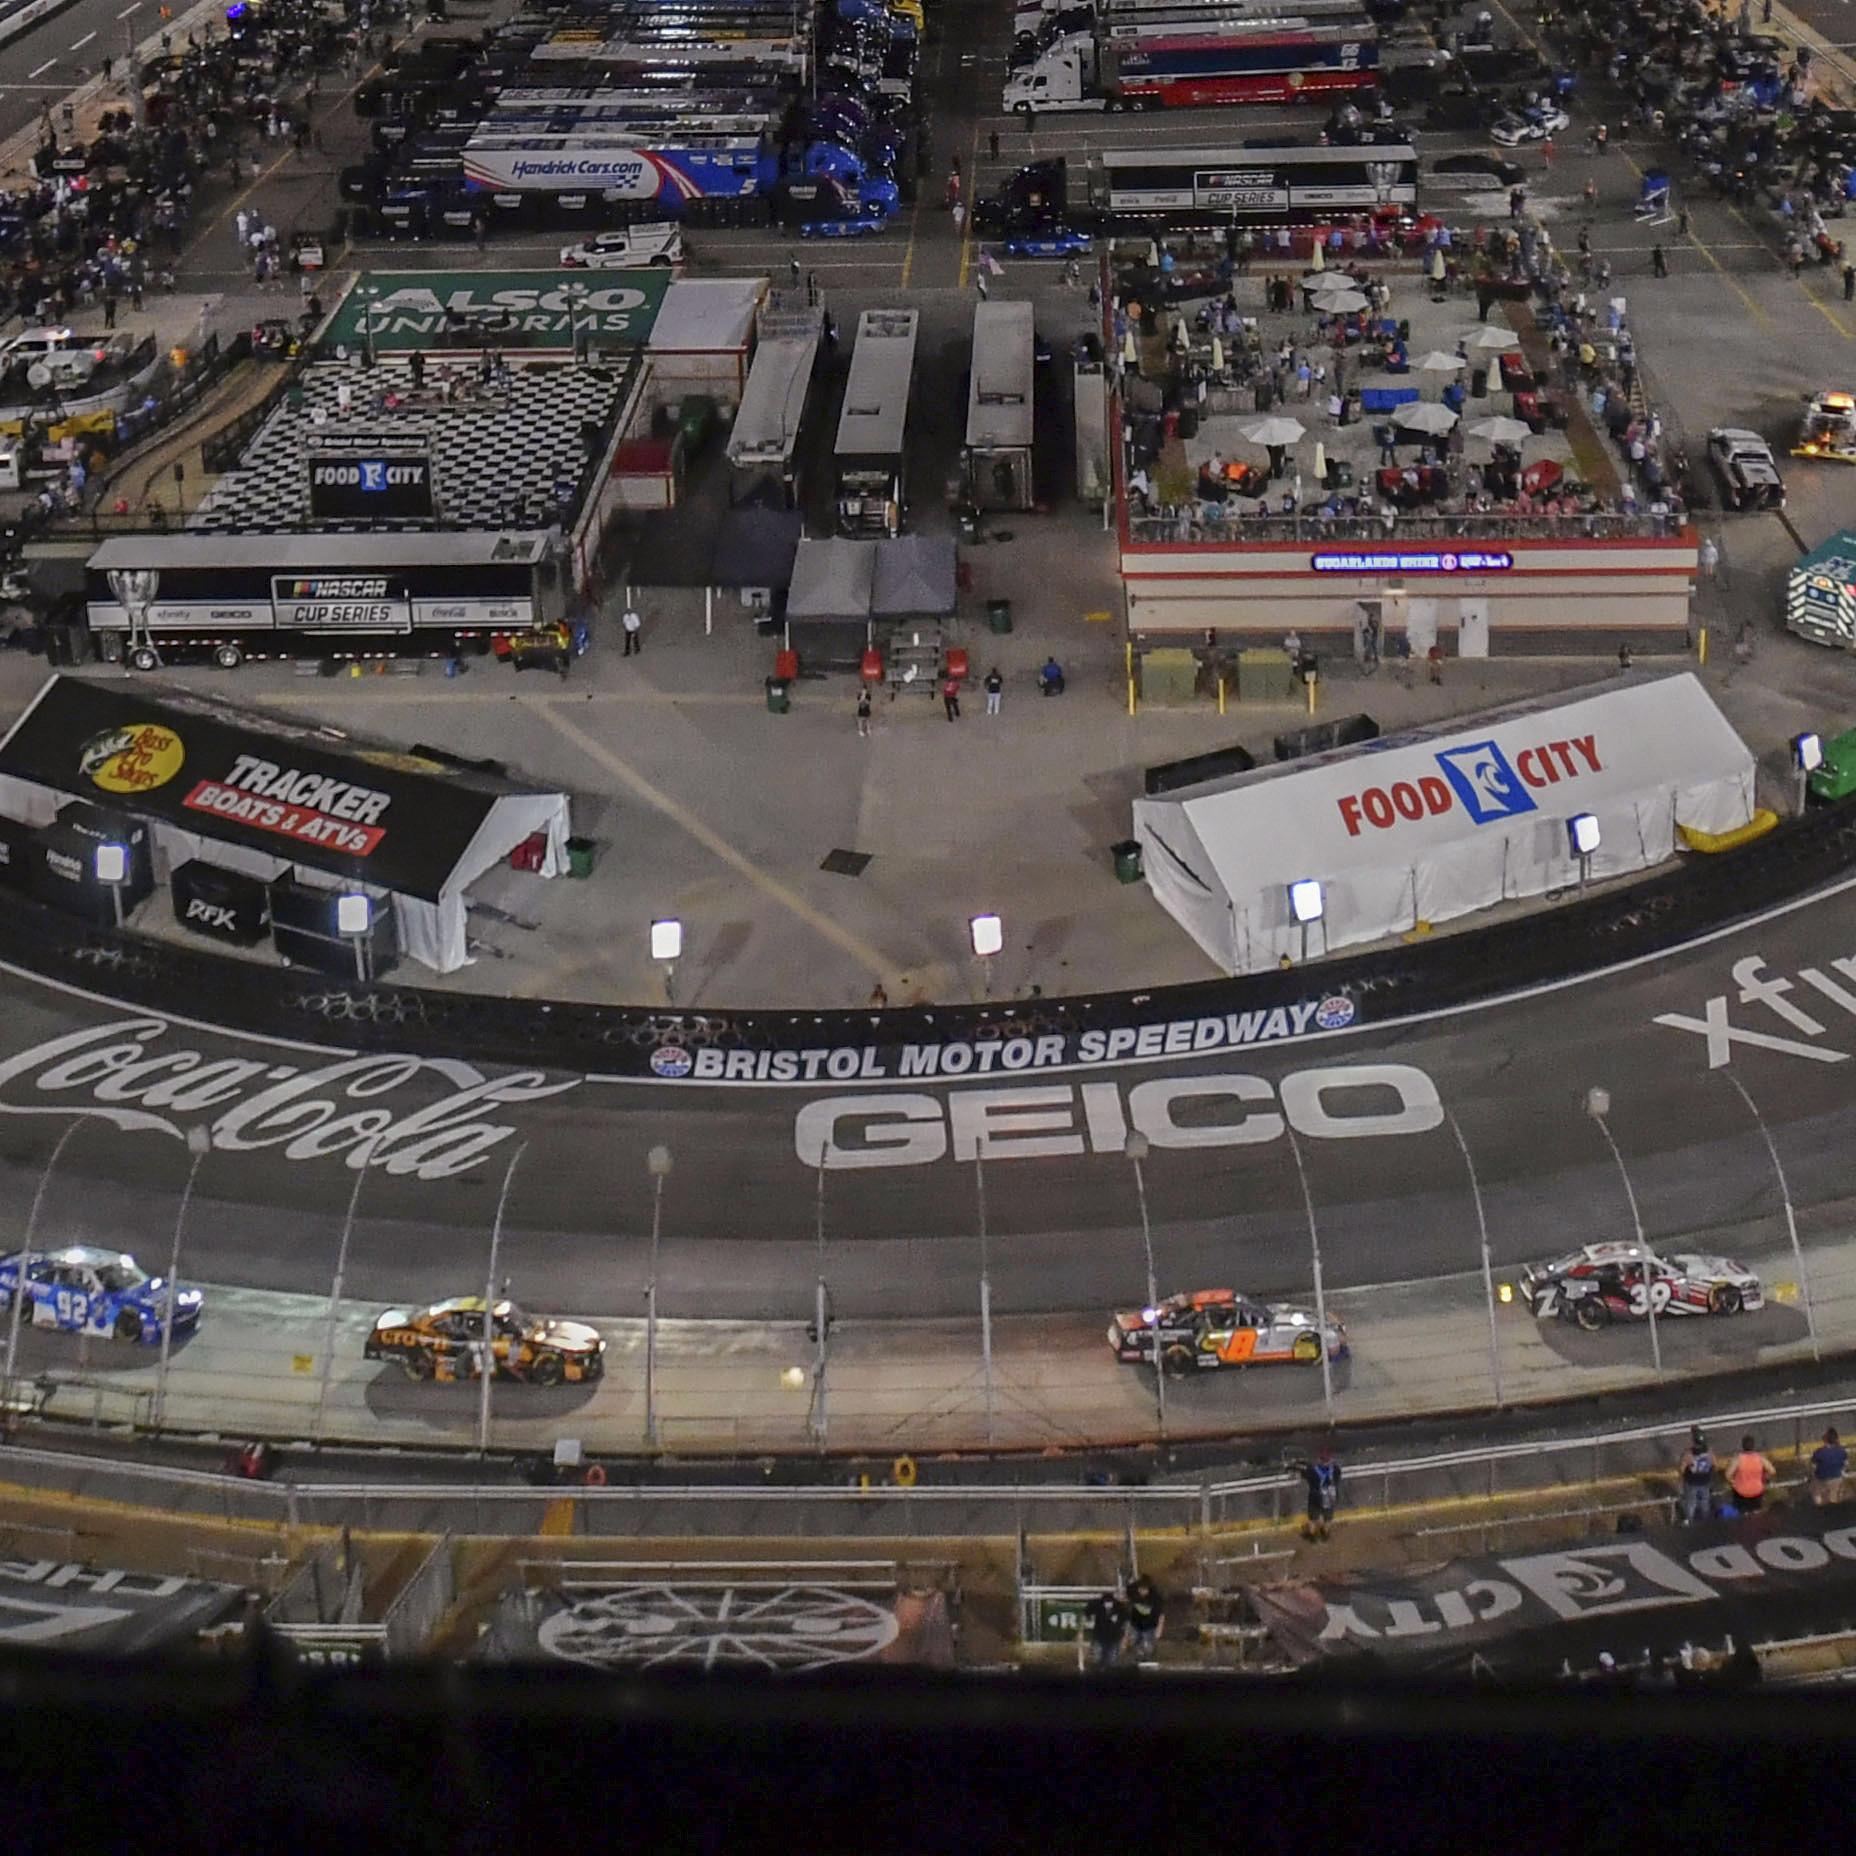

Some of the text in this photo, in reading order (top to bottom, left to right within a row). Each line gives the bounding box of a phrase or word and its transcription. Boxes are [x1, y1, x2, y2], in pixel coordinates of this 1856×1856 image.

[738, 178, 757, 195] 5
[1208, 191, 1275, 205] CUP SERIES
[369, 287, 646, 313] ALSCO
[314, 465, 423, 485] FOOD CITY
[315, 580, 387, 598] NASCAR
[294, 605, 392, 623] CUP SERIES
[134, 726, 173, 754] Bass
[107, 763, 160, 789] Shops
[224, 753, 391, 825] TRACKER
[1337, 734, 1606, 837] FOOD CITY
[193, 784, 368, 851] BOATS & ATVs
[693, 1001, 1322, 1081] BRISTOL MOTOR SPEEDWAY
[795, 1063, 1445, 1170] GEICO
[53, 1288, 84, 1321] 92
[1628, 1282, 1672, 1316] 39
[1321, 1575, 1523, 1640] CITY
